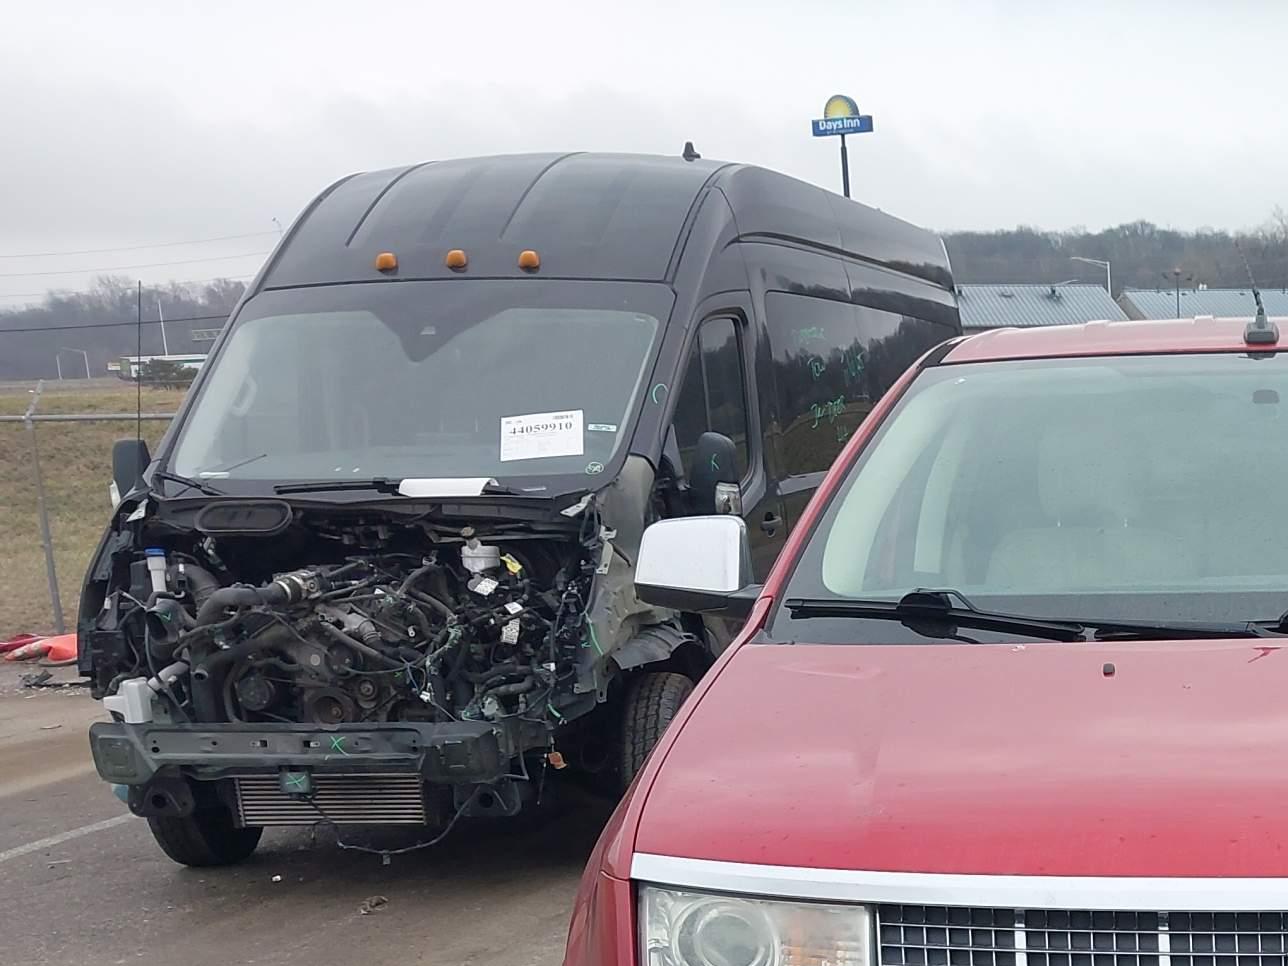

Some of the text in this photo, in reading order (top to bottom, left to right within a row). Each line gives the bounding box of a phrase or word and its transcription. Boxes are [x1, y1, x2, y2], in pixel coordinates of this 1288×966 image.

[819, 118, 860, 131] Days Inn
[509, 422, 573, 434] 44059910
